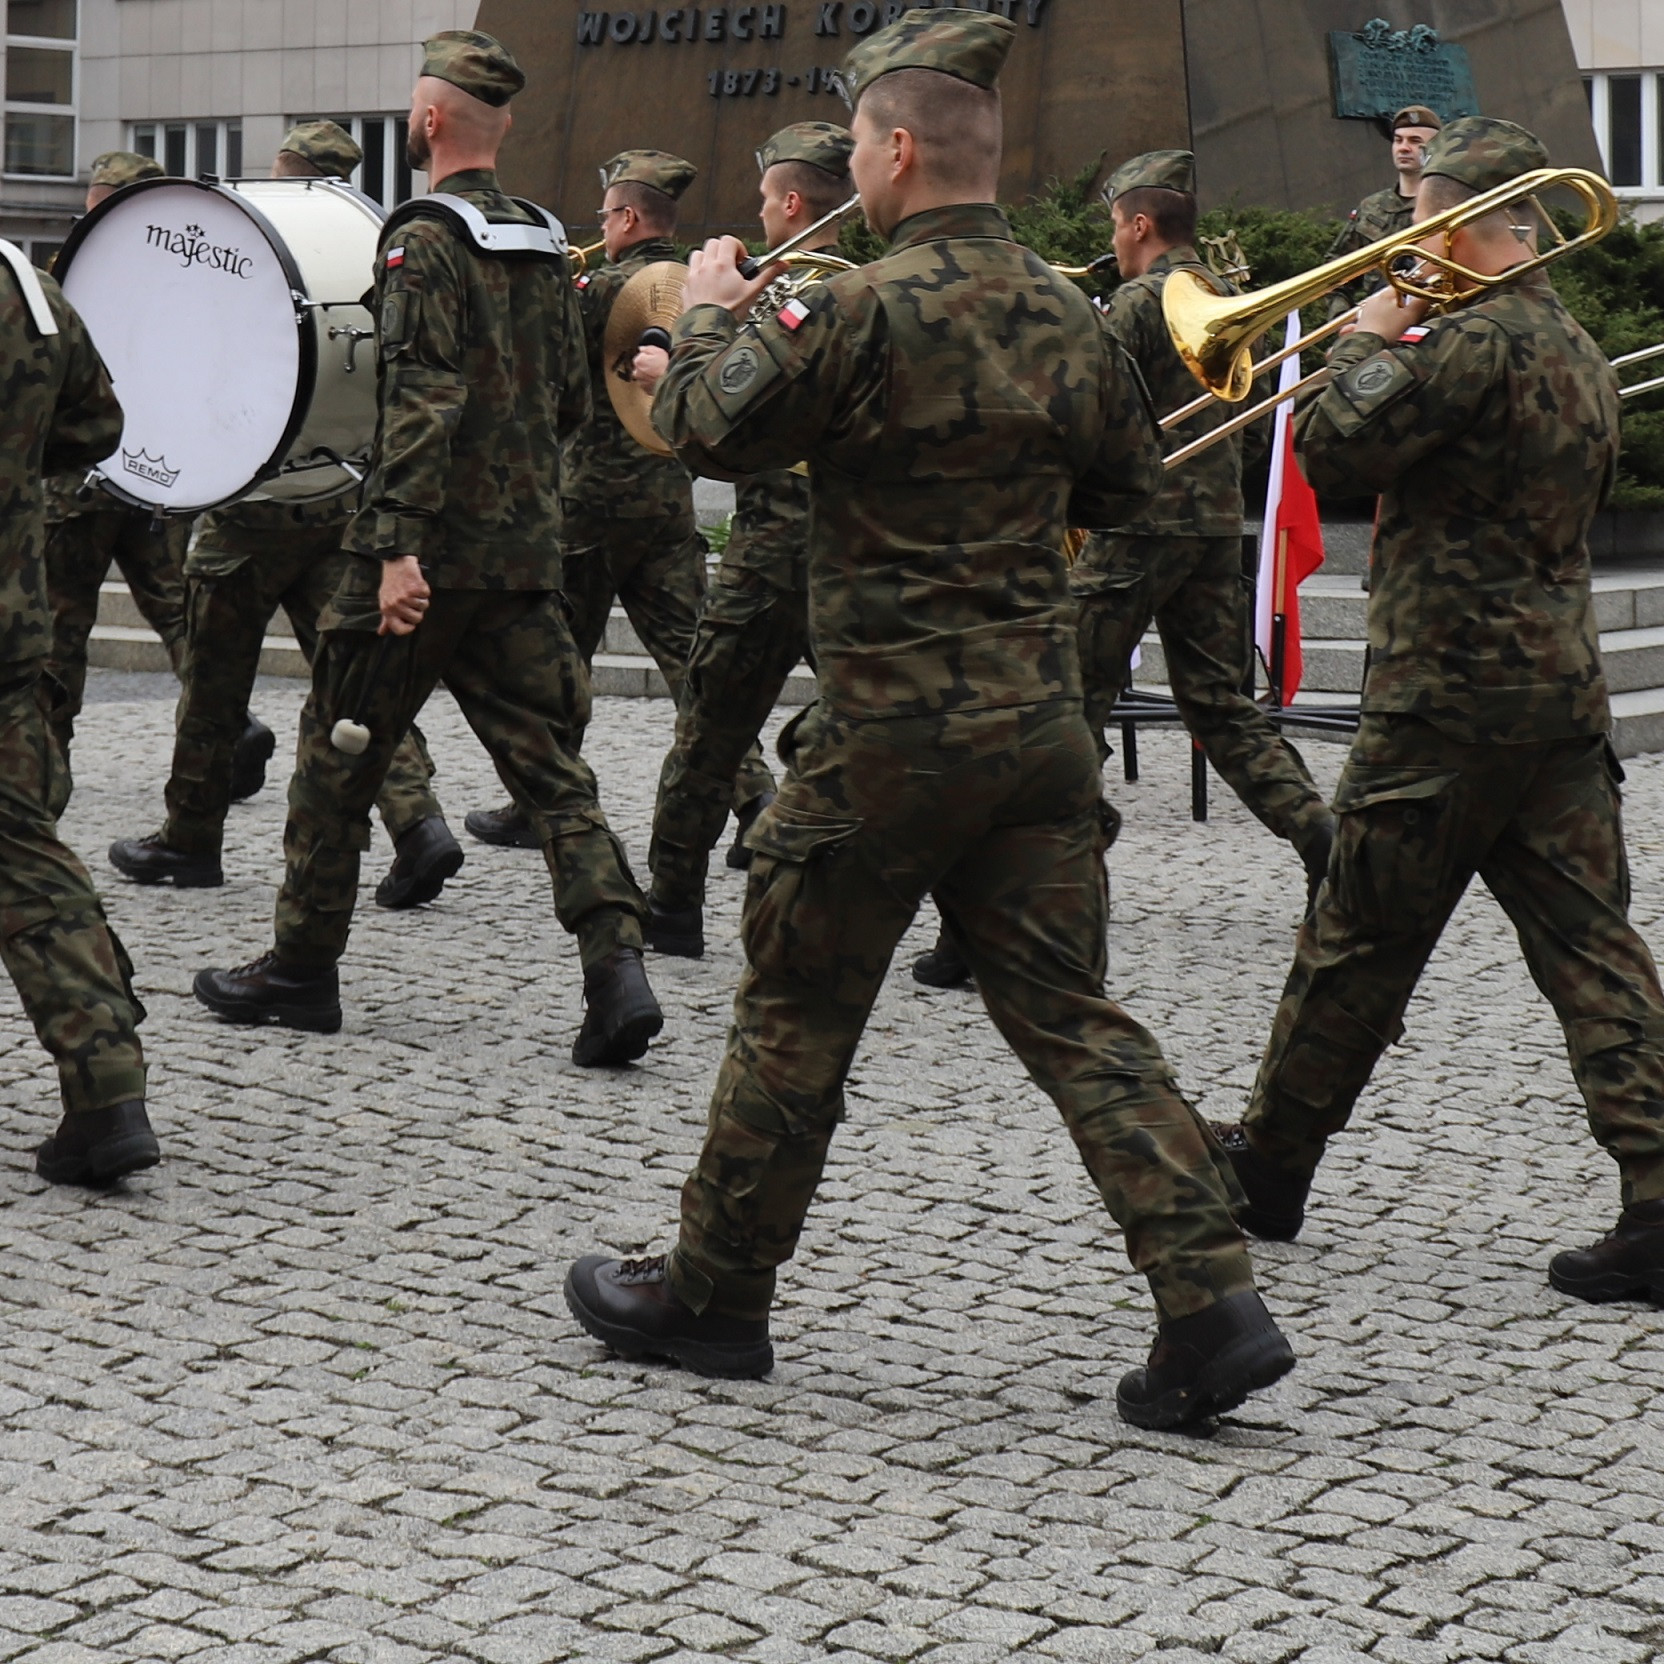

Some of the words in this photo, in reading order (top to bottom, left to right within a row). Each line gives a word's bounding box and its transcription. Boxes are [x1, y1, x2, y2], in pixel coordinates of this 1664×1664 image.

[577, 3, 786, 44] WOJCIECH
[146, 224, 253, 279] majestic
[128, 459, 170, 483] REMO
